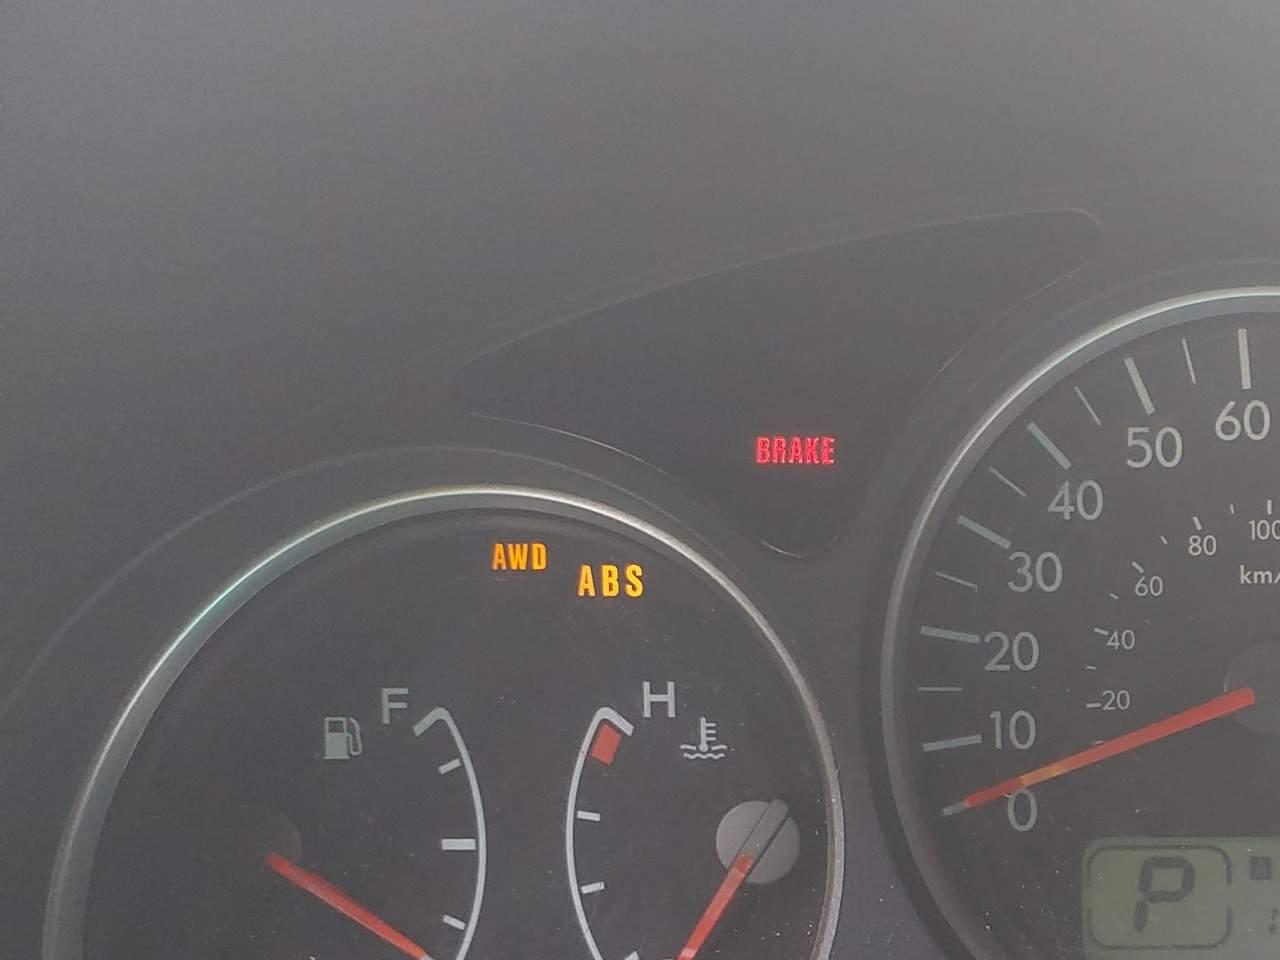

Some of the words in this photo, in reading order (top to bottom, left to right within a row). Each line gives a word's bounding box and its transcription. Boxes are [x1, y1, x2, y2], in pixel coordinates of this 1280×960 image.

[1214, 400, 1271, 441] 60
[755, 436, 836, 465] BRAKE
[1125, 426, 1183, 468] 50
[1048, 480, 1104, 519] 40
[491, 543, 548, 572] AWD
[1187, 535, 1218, 557] 80
[578, 565, 644, 598] ABS
[1007, 551, 1062, 592] 30
[1134, 576, 1164, 597] 60
[985, 629, 1040, 672] 20
[1106, 630, 1136, 651] 40
[381, 688, 408, 725] F
[642, 681, 677, 718] H
[1102, 690, 1131, 711] 20
[990, 708, 1038, 750] 10
[1008, 790, 1038, 831] 0
[1134, 857, 1195, 932] P
